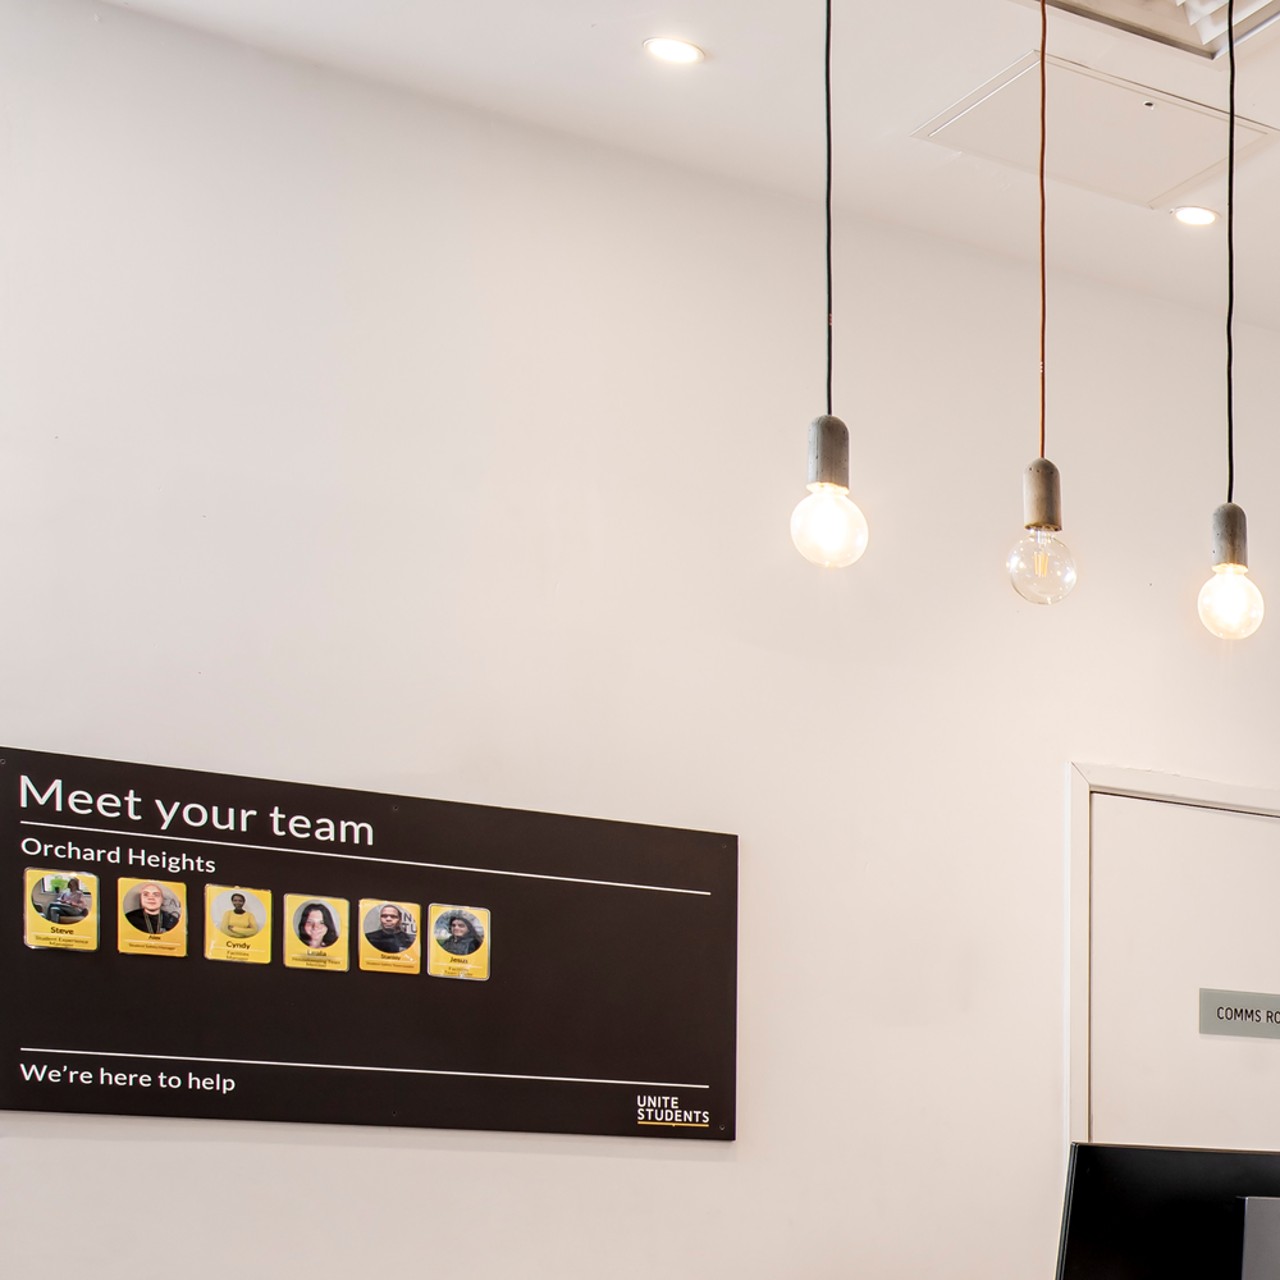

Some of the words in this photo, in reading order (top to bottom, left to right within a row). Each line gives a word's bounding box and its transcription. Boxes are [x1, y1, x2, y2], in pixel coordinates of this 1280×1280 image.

[19, 774, 142, 821] Meet
[154, 798, 257, 832] your
[269, 806, 374, 846] team
[21, 837, 121, 864] Orchard
[128, 848, 216, 873] Heights
[50, 926, 74, 935] Steve
[226, 940, 251, 950] Cyndy
[1216, 1006, 1262, 1023] COMMS
[100, 1067, 152, 1087] here
[158, 1072, 182, 1089] to
[187, 1071, 236, 1094] help
[636, 1095, 679, 1109] UNITE
[637, 1108, 710, 1123] STUDENTS
